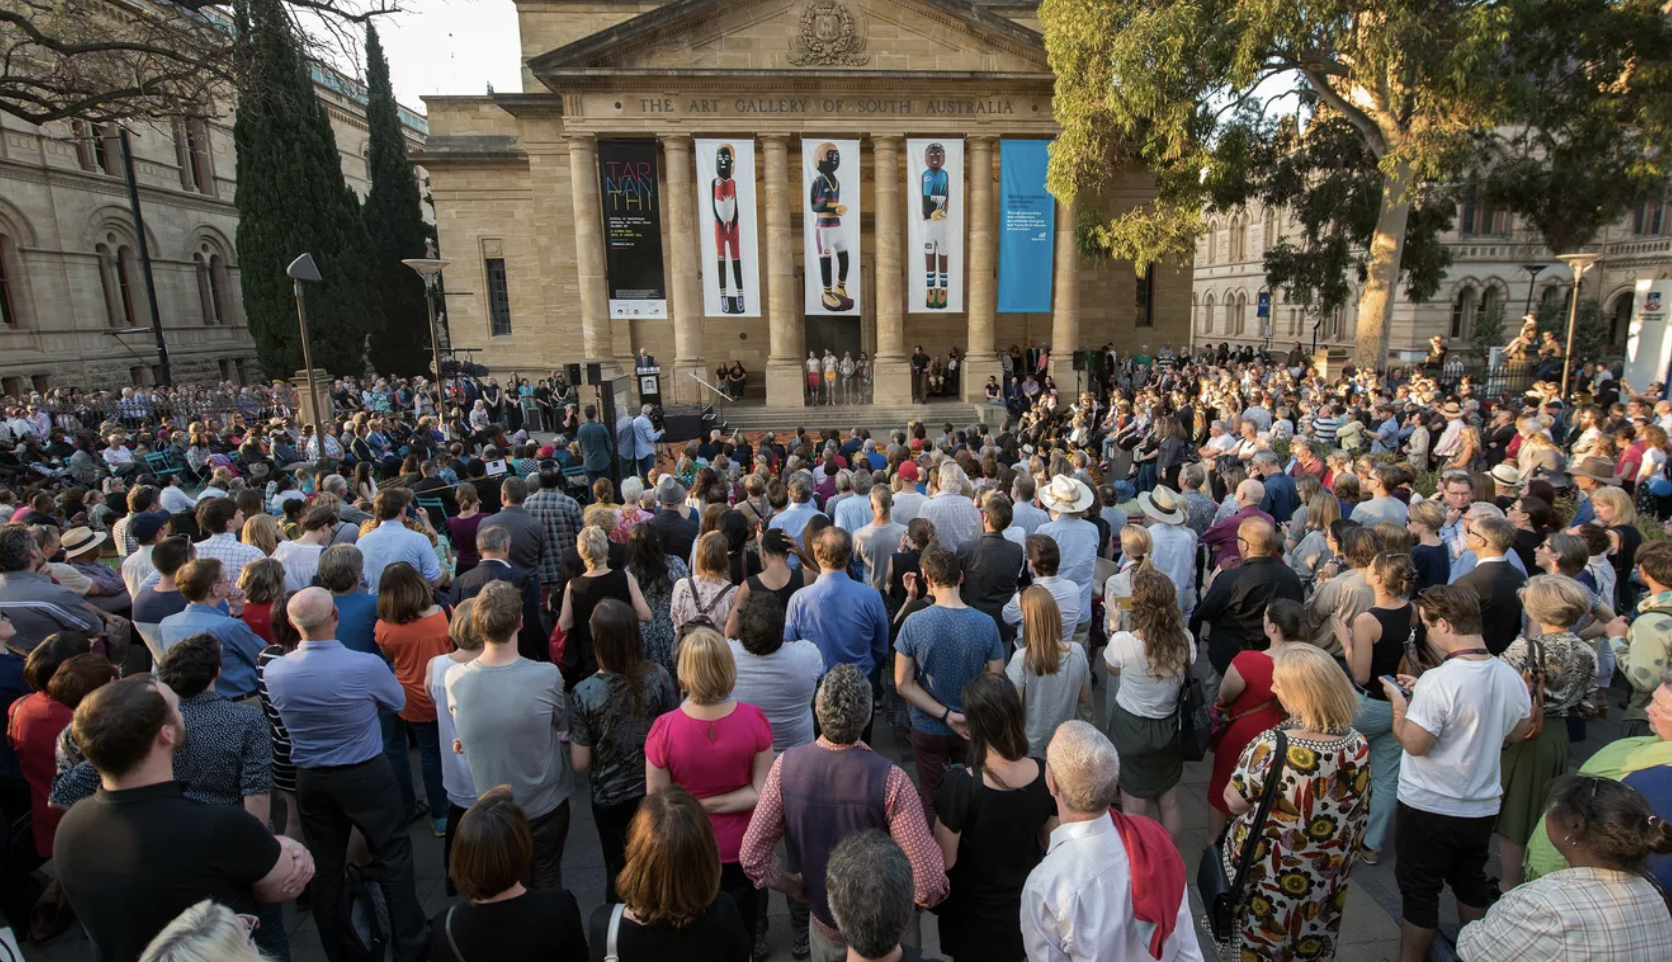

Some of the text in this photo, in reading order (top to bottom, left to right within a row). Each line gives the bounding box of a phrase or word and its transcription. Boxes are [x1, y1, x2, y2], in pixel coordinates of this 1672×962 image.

[639, 99, 1014, 114] THE ART GALLERY OF SOUTH AUSTRALIA
[606, 161, 652, 182] TAR
[606, 176, 653, 196] NAN
[608, 190, 652, 211] THI
